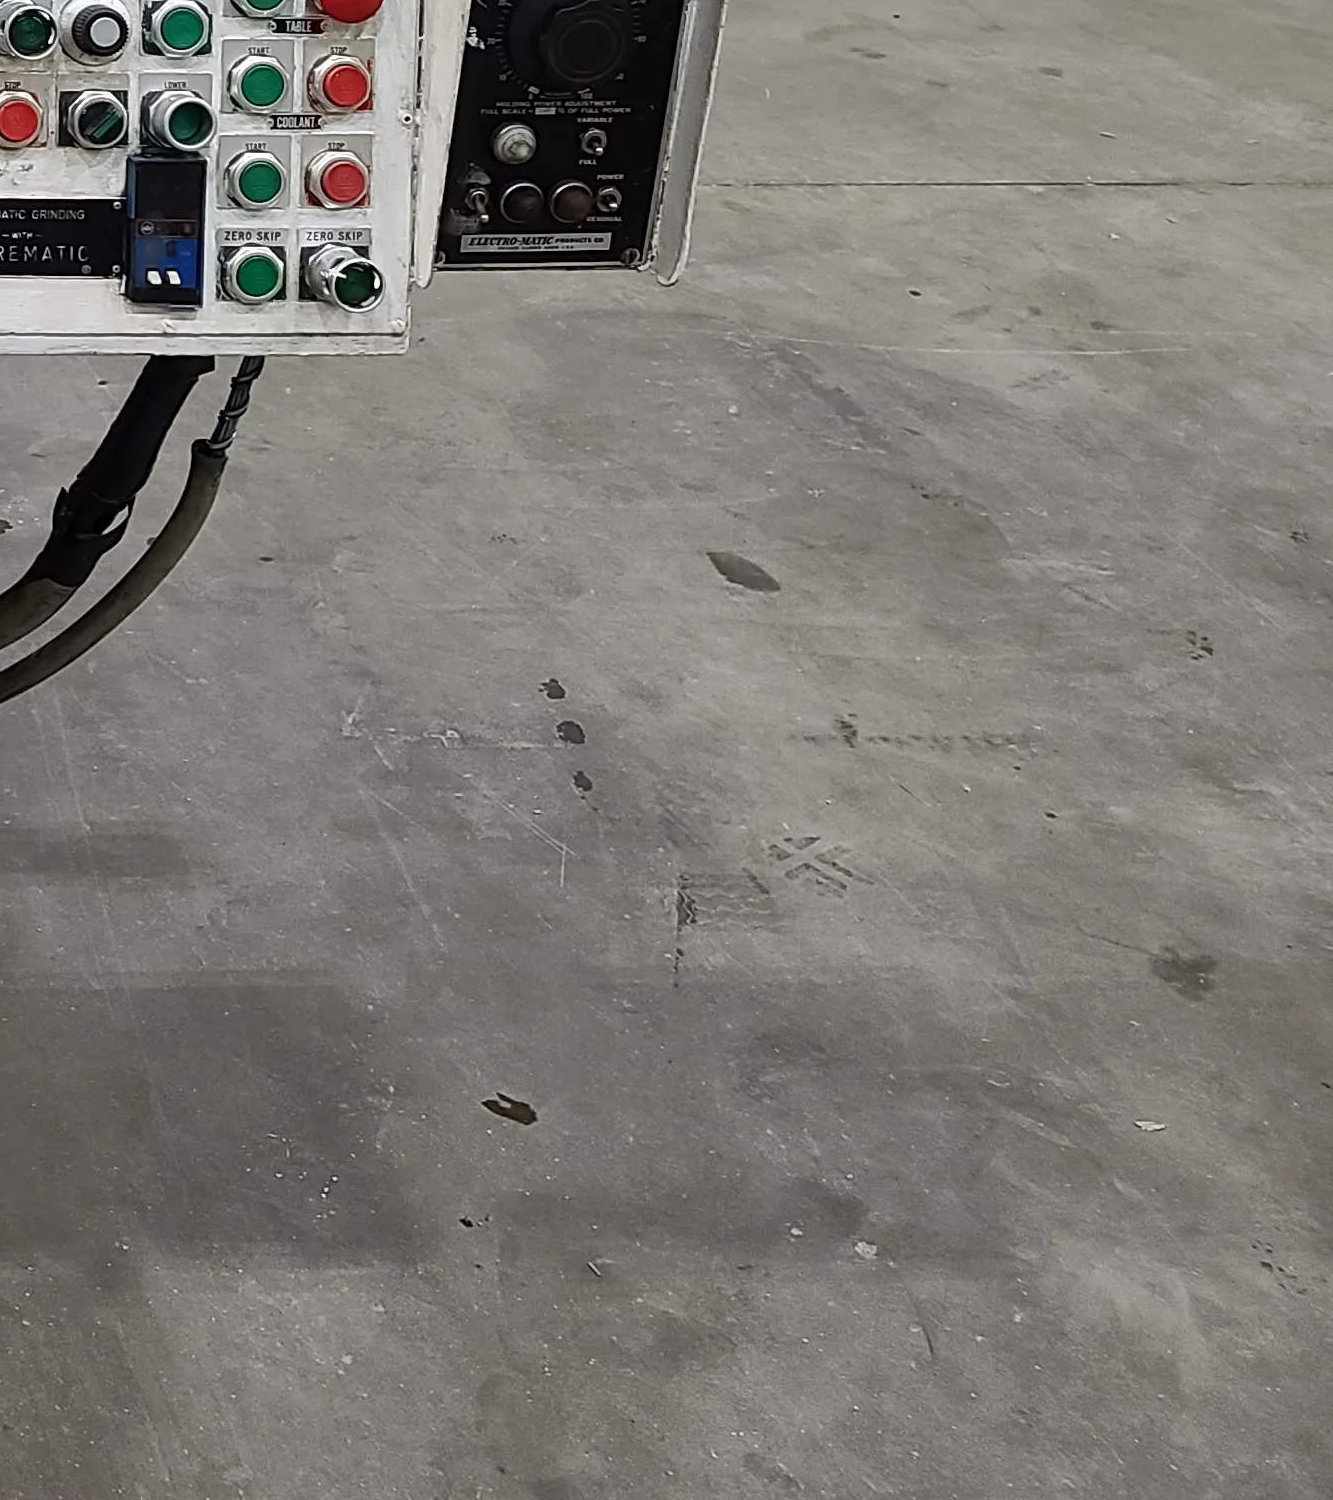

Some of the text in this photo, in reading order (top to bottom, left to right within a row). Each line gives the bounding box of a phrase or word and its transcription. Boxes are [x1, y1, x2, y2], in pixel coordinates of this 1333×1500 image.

[285, 20, 312, 32] TABLE
[276, 116, 316, 128] COOLANT
[245, 142, 266, 150] START
[31, 209, 85, 220] GRINDING
[224, 231, 281, 241] ZERO SKIP
[306, 231, 363, 241] ZERO SKIP
[468, 236, 555, 246] ELECTRO-MATIC
